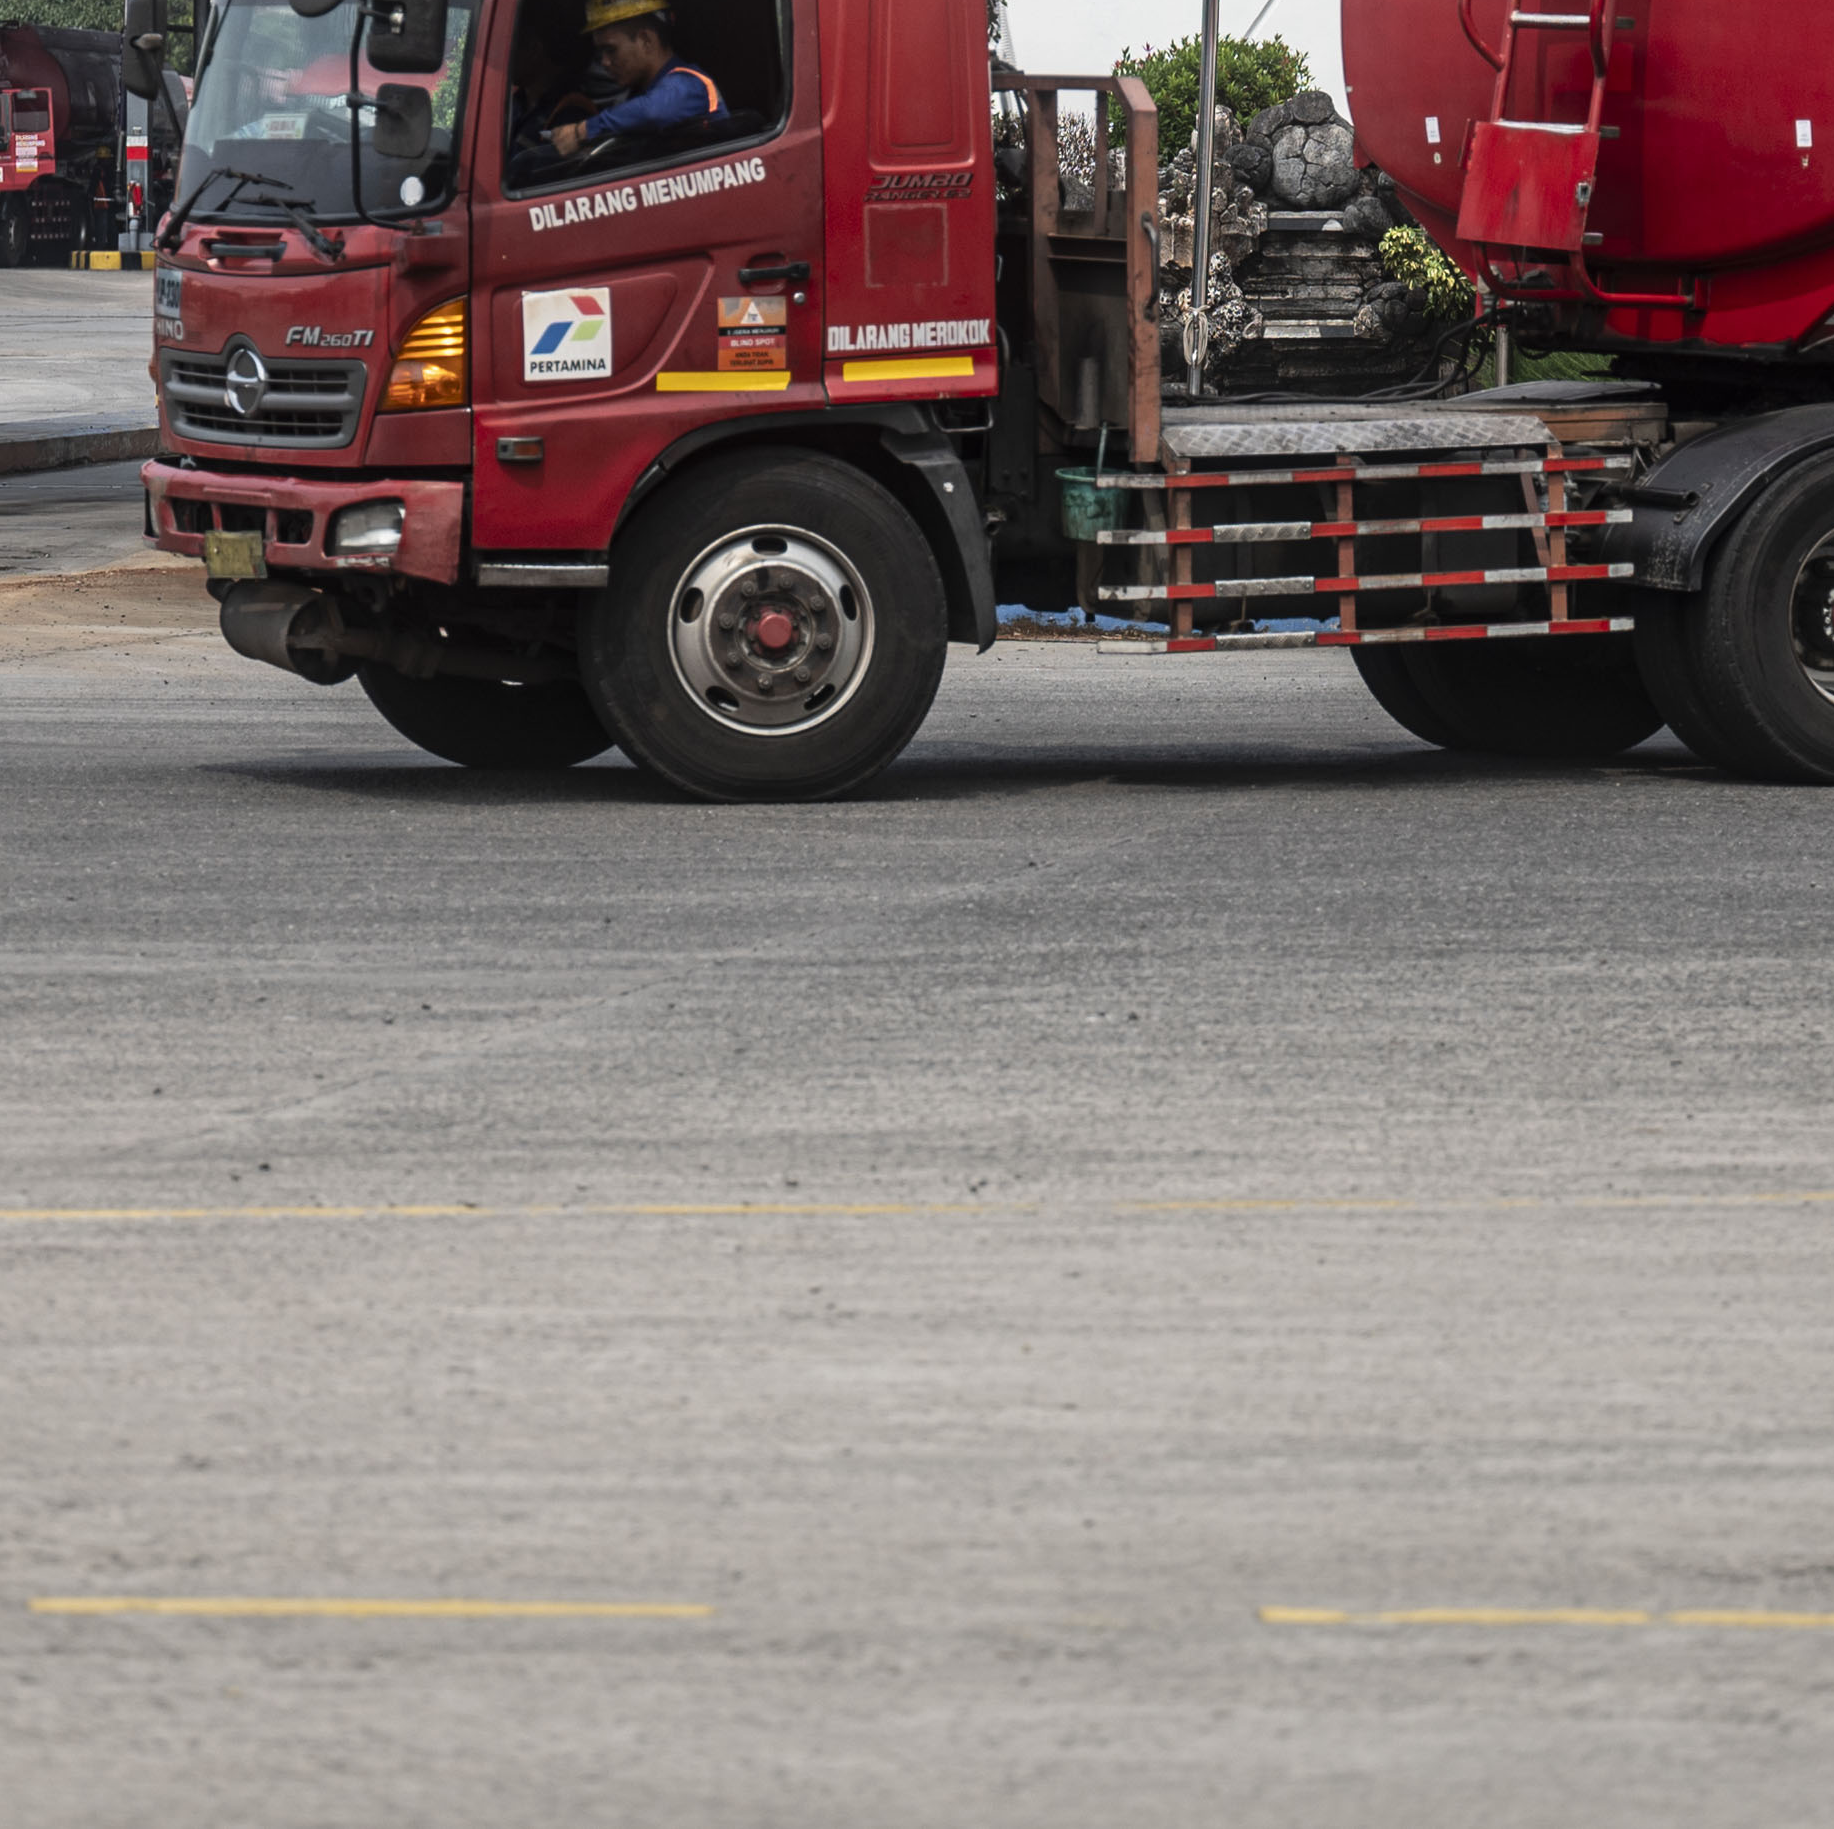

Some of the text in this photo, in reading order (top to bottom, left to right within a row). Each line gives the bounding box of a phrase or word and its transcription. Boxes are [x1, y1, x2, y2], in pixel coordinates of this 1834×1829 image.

[869, 172, 974, 190] JUMBO
[529, 157, 766, 232] DILARANG MENUMPANG
[730, 337, 776, 348] BLIND SPOT
[827, 318, 990, 352] DILARANG MEROKOK
[530, 357, 607, 374] PERTAMINA
